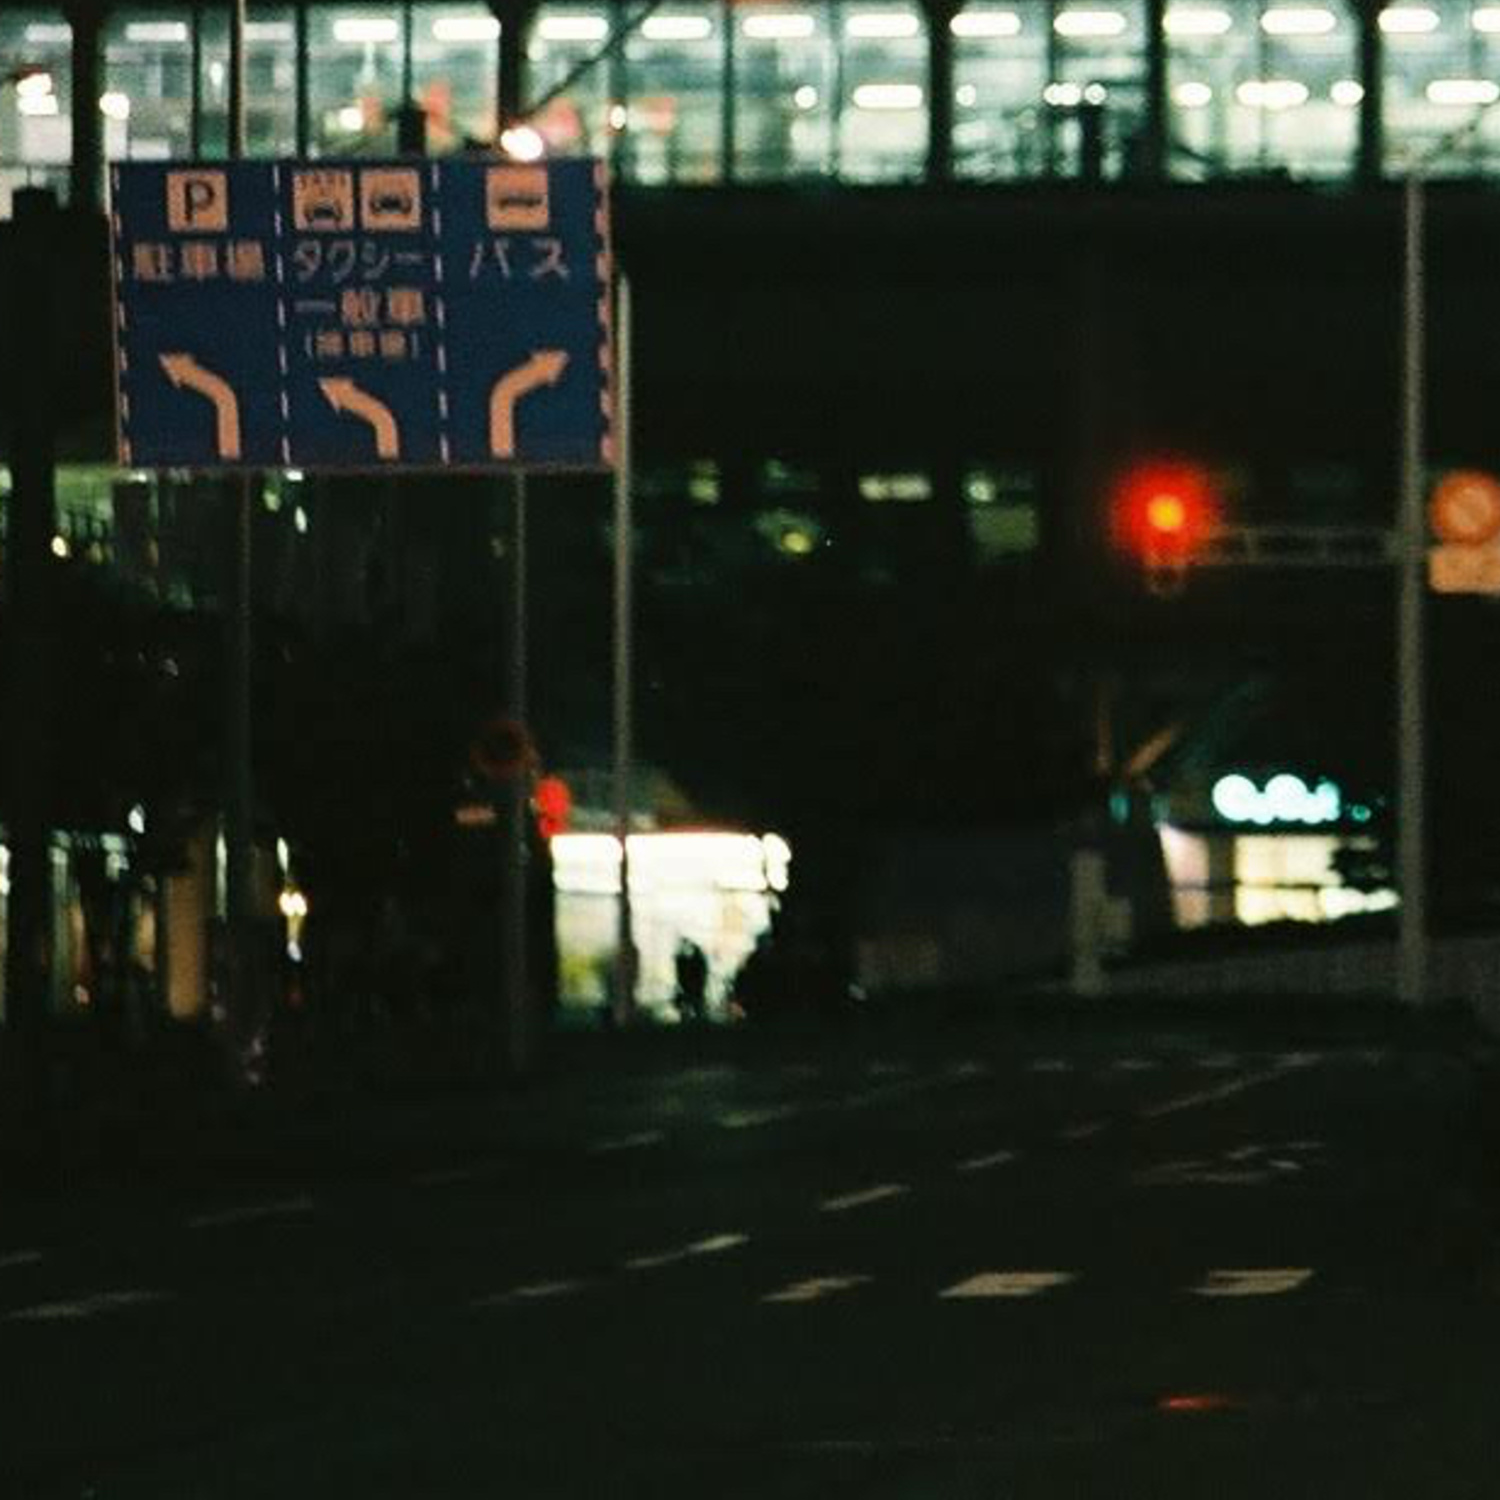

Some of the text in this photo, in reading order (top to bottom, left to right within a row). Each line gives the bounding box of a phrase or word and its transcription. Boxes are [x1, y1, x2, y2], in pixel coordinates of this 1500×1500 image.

[294, 240, 433, 282] タクシー
[469, 239, 571, 279] バス
